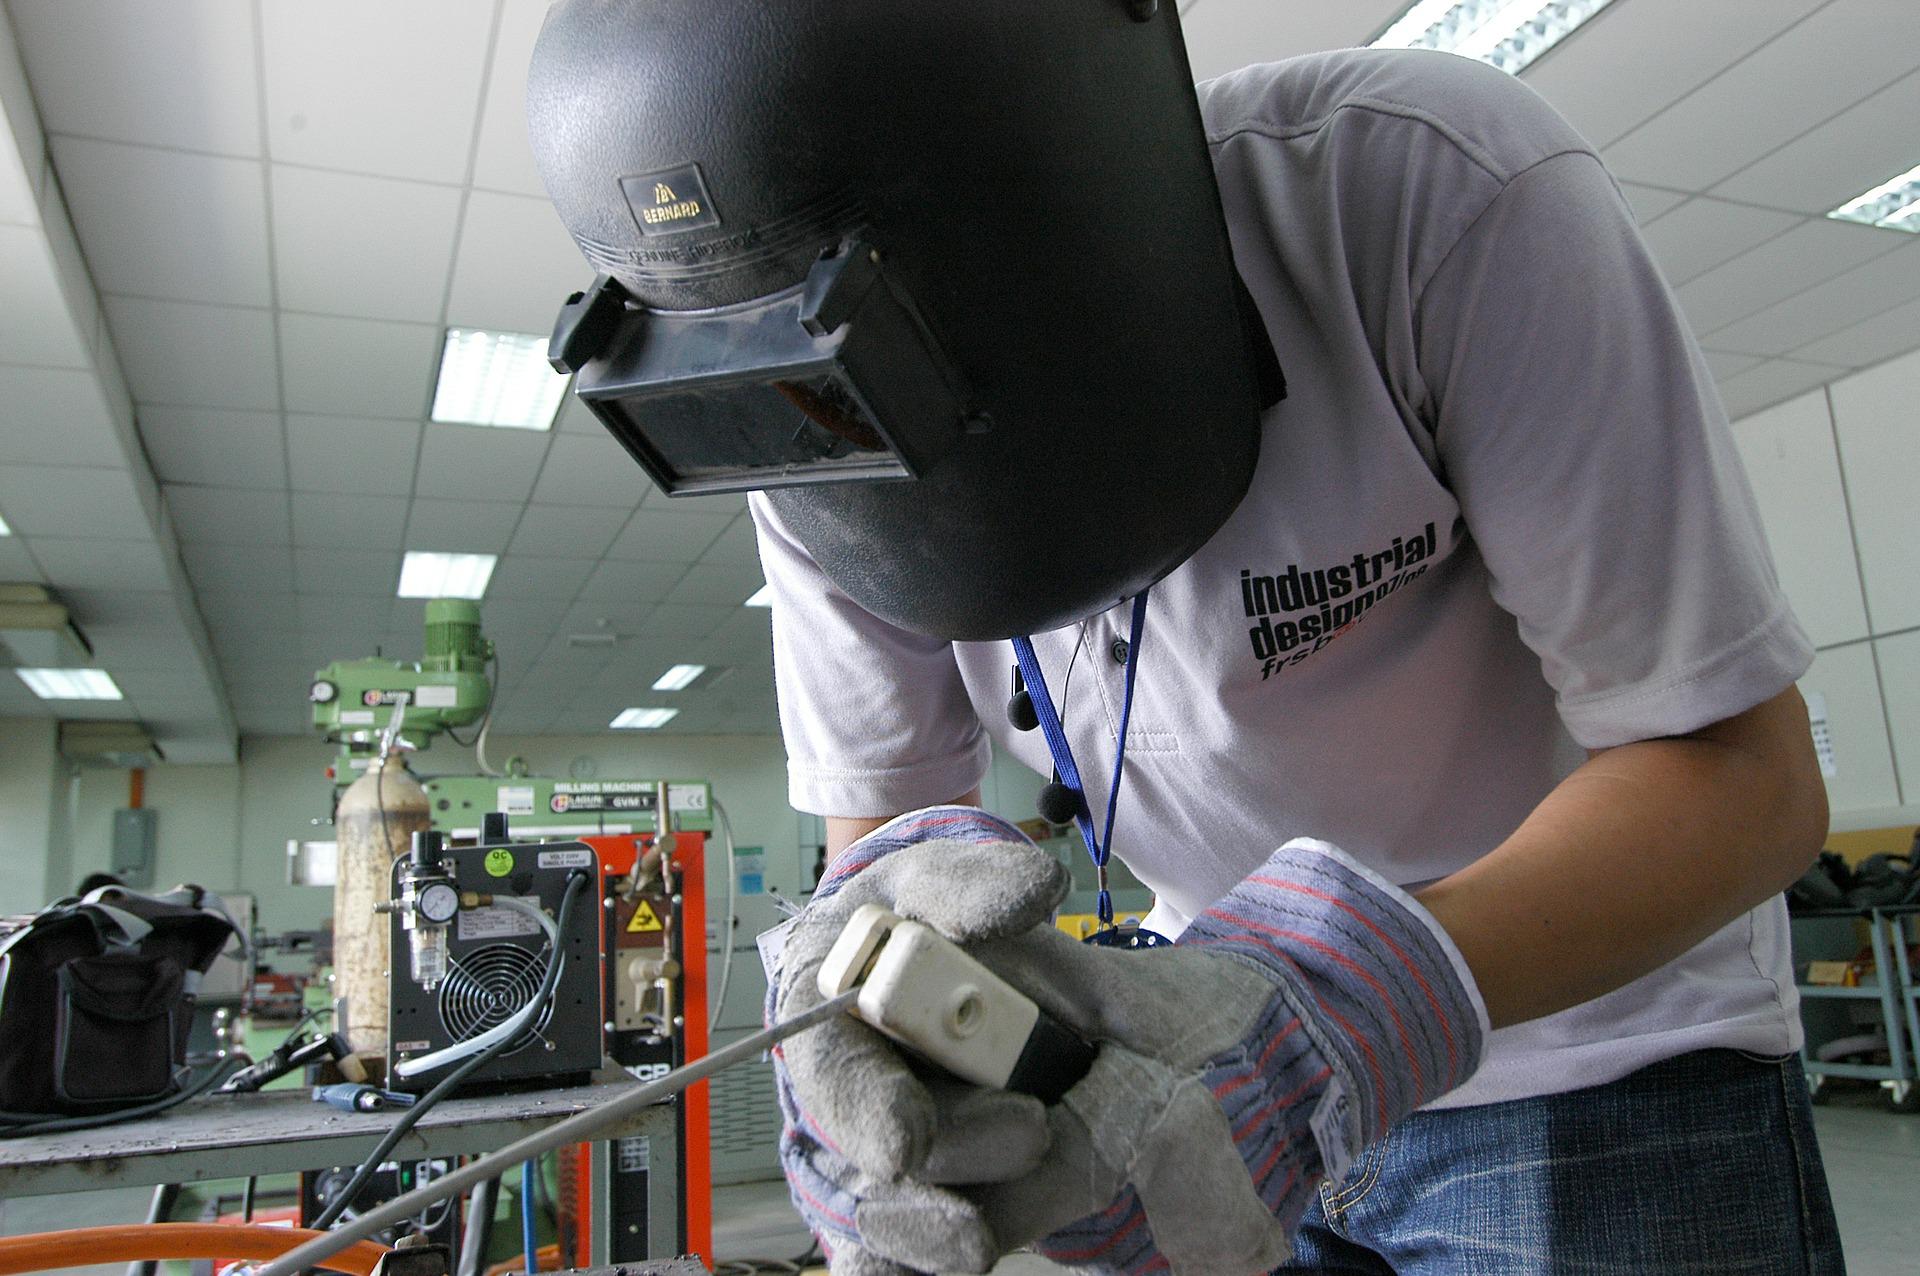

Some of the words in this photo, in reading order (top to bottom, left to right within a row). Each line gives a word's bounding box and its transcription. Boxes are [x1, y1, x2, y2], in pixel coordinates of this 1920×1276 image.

[643, 201, 700, 224] BERNARD
[1241, 522, 1436, 618] industrial
[554, 782, 600, 793] MILLING
[602, 782, 653, 793] MACHINE
[492, 851, 507, 860] QC
[624, 1063, 671, 1081] CP
